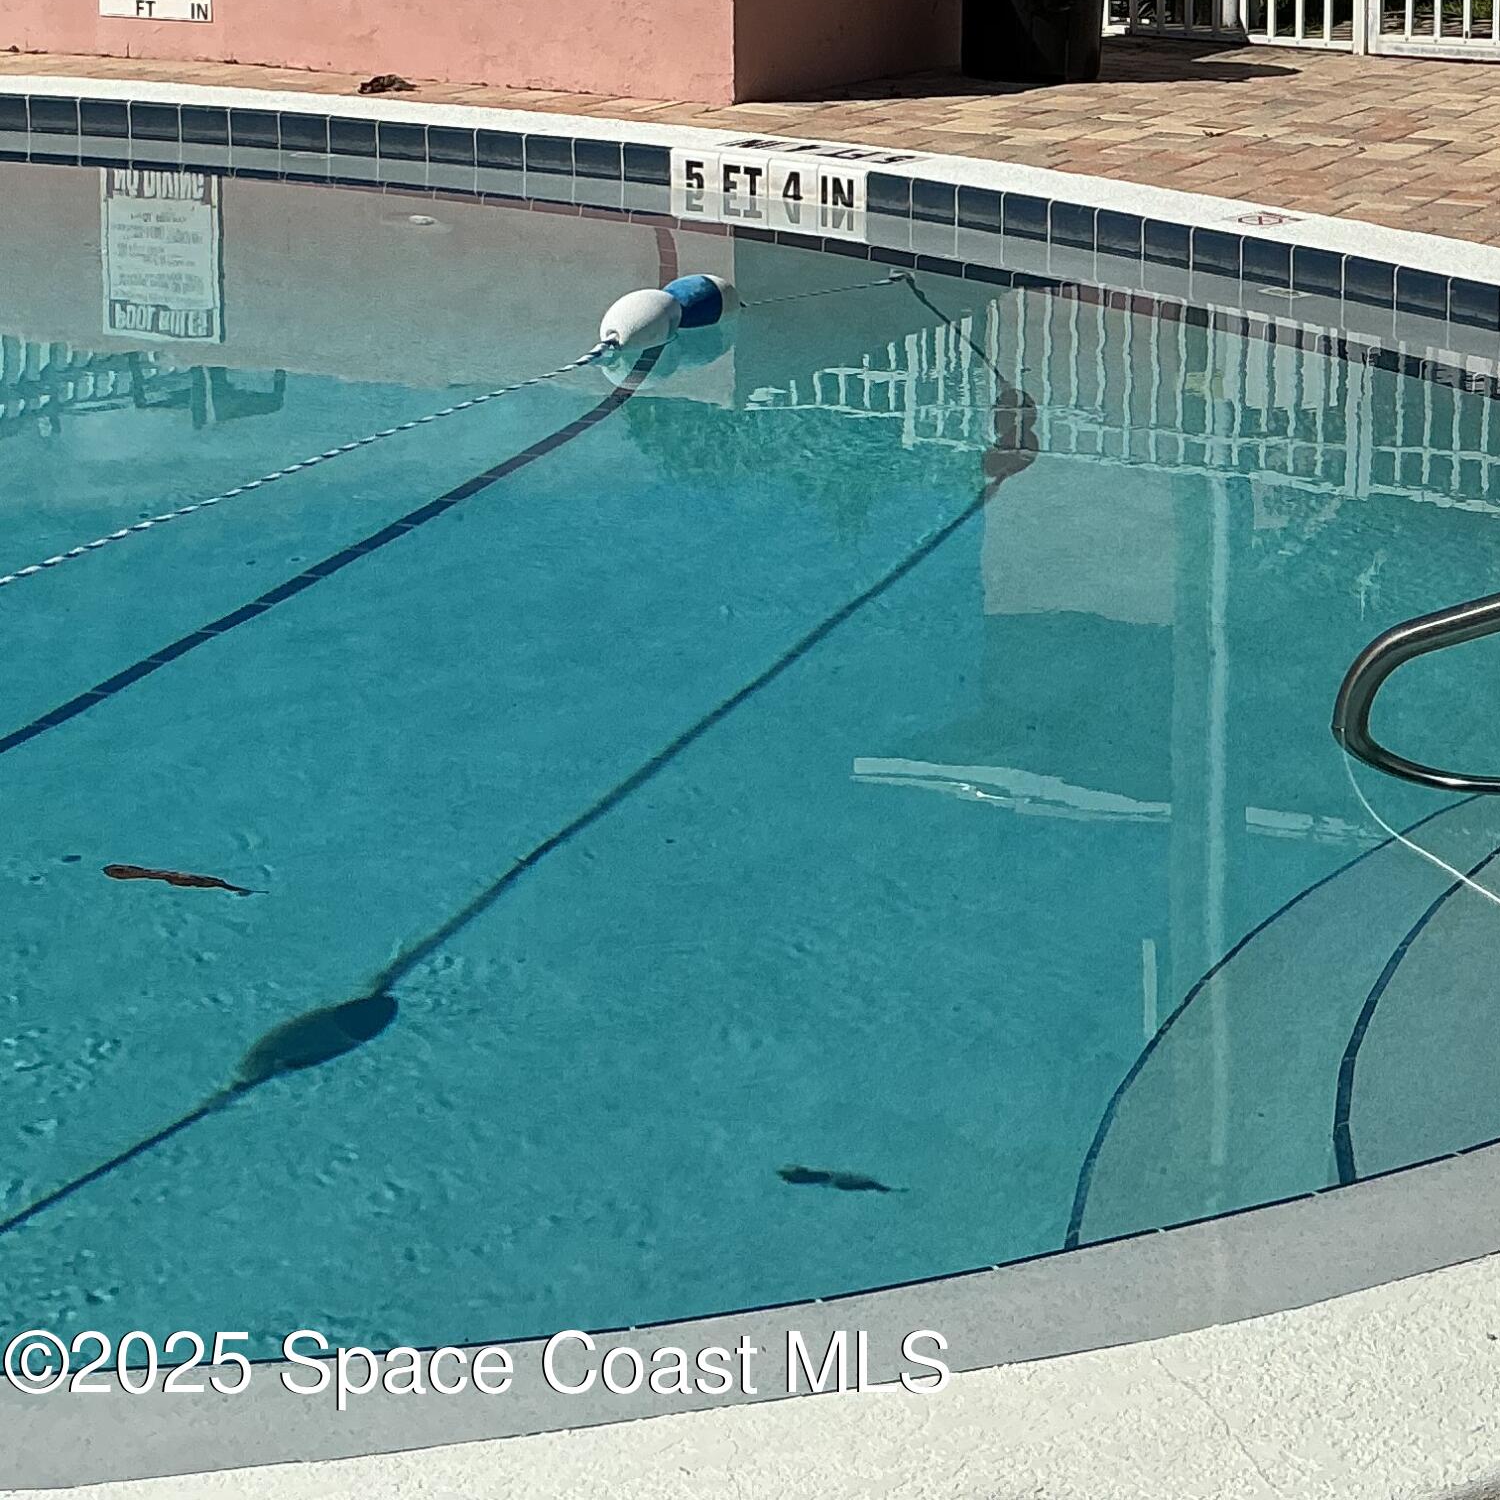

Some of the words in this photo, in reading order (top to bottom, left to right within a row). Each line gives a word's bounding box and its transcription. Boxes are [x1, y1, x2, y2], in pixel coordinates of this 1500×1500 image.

[135, 0, 156, 17] FT
[190, 3, 208, 20] IN
[685, 159, 704, 189] 5
[722, 163, 762, 196] FT
[782, 171, 803, 201] 4
[821, 175, 854, 208] IN
